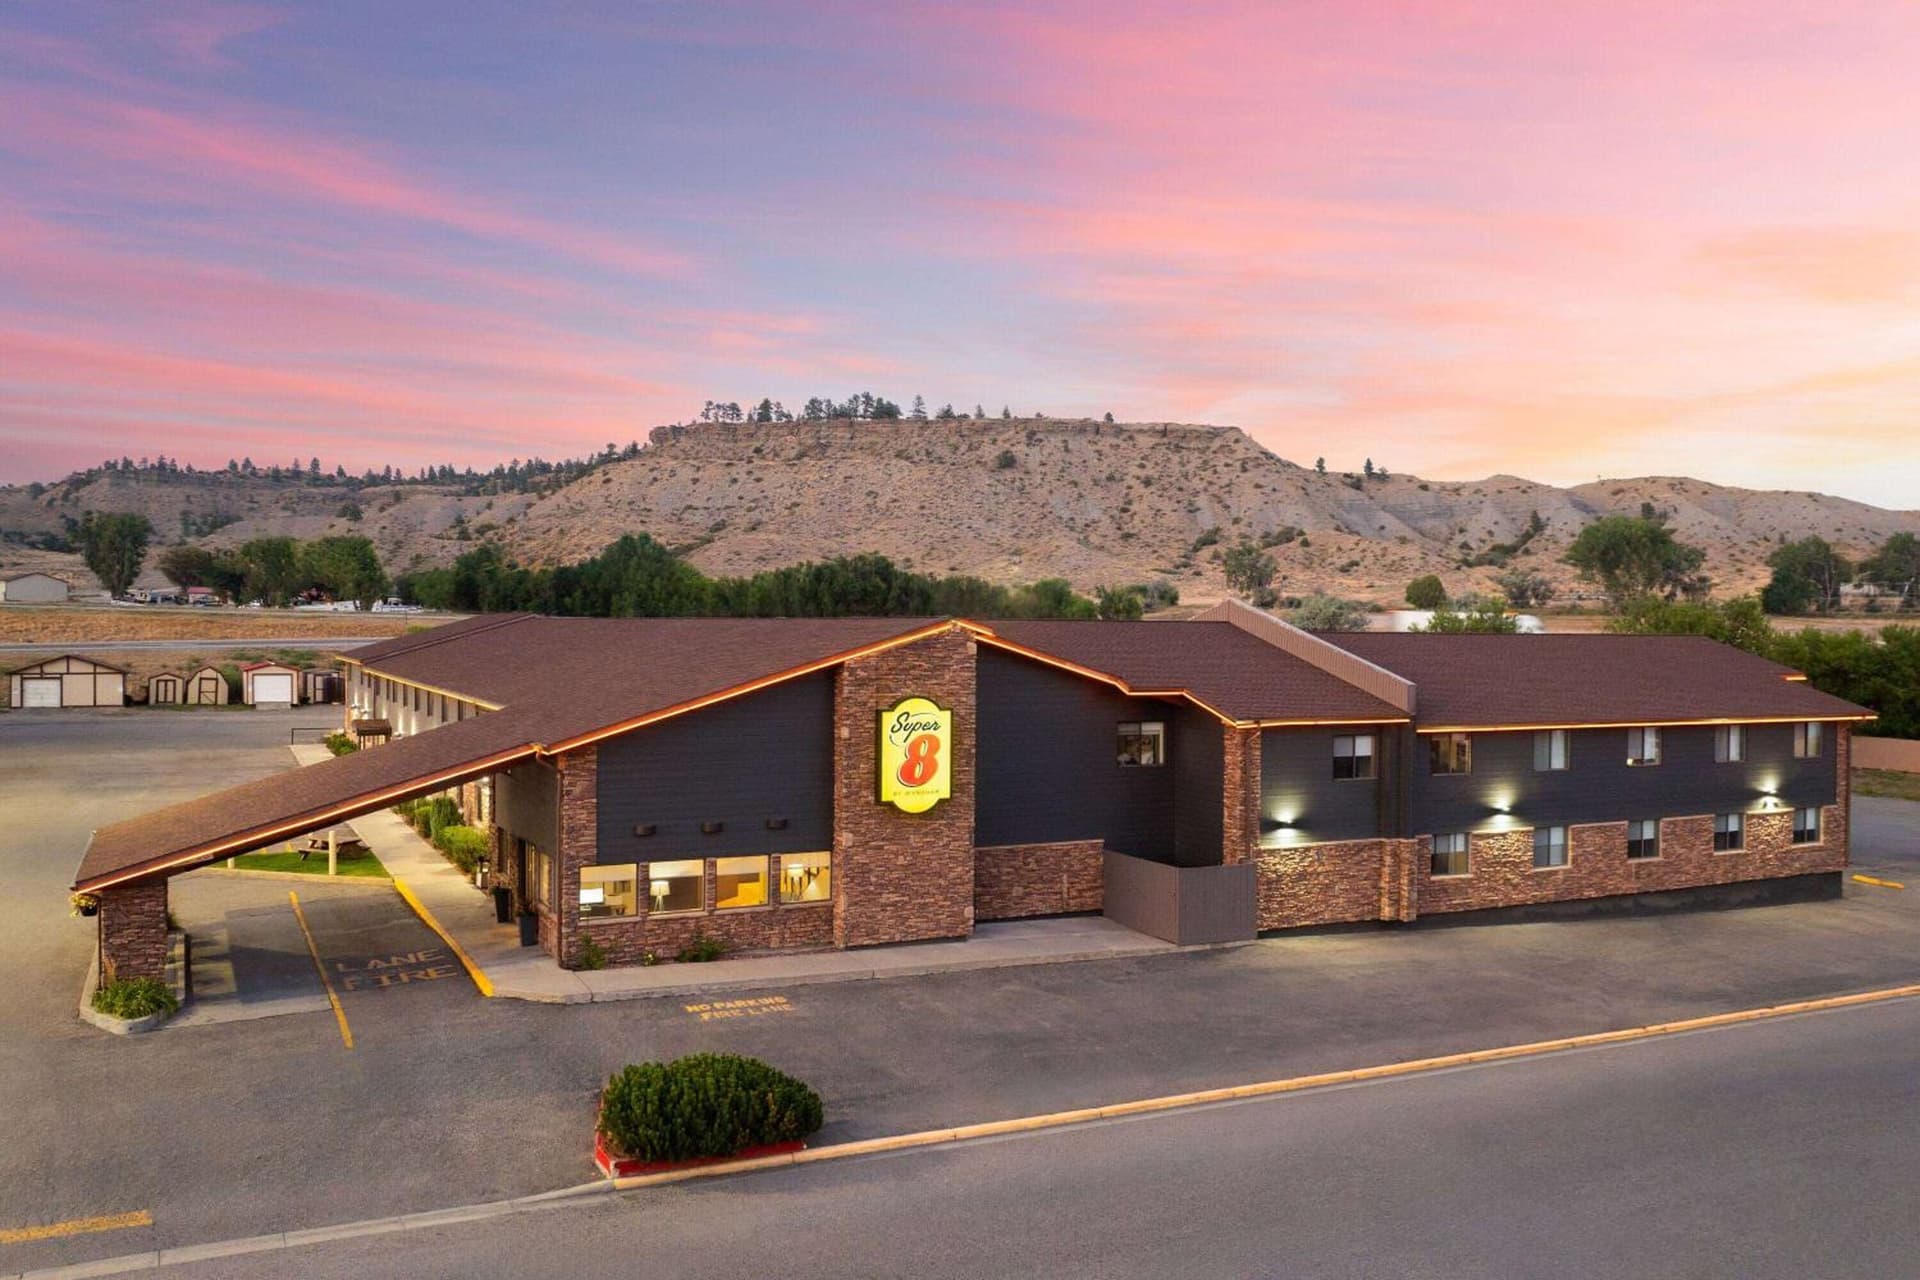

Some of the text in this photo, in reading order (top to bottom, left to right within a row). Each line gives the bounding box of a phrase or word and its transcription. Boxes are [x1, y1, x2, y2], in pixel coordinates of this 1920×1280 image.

[890, 711, 941, 743] Super
[896, 733, 941, 788] 8
[337, 949, 445, 972] LANE
[345, 964, 457, 990] FIRE
[685, 1003, 712, 1013] NO
